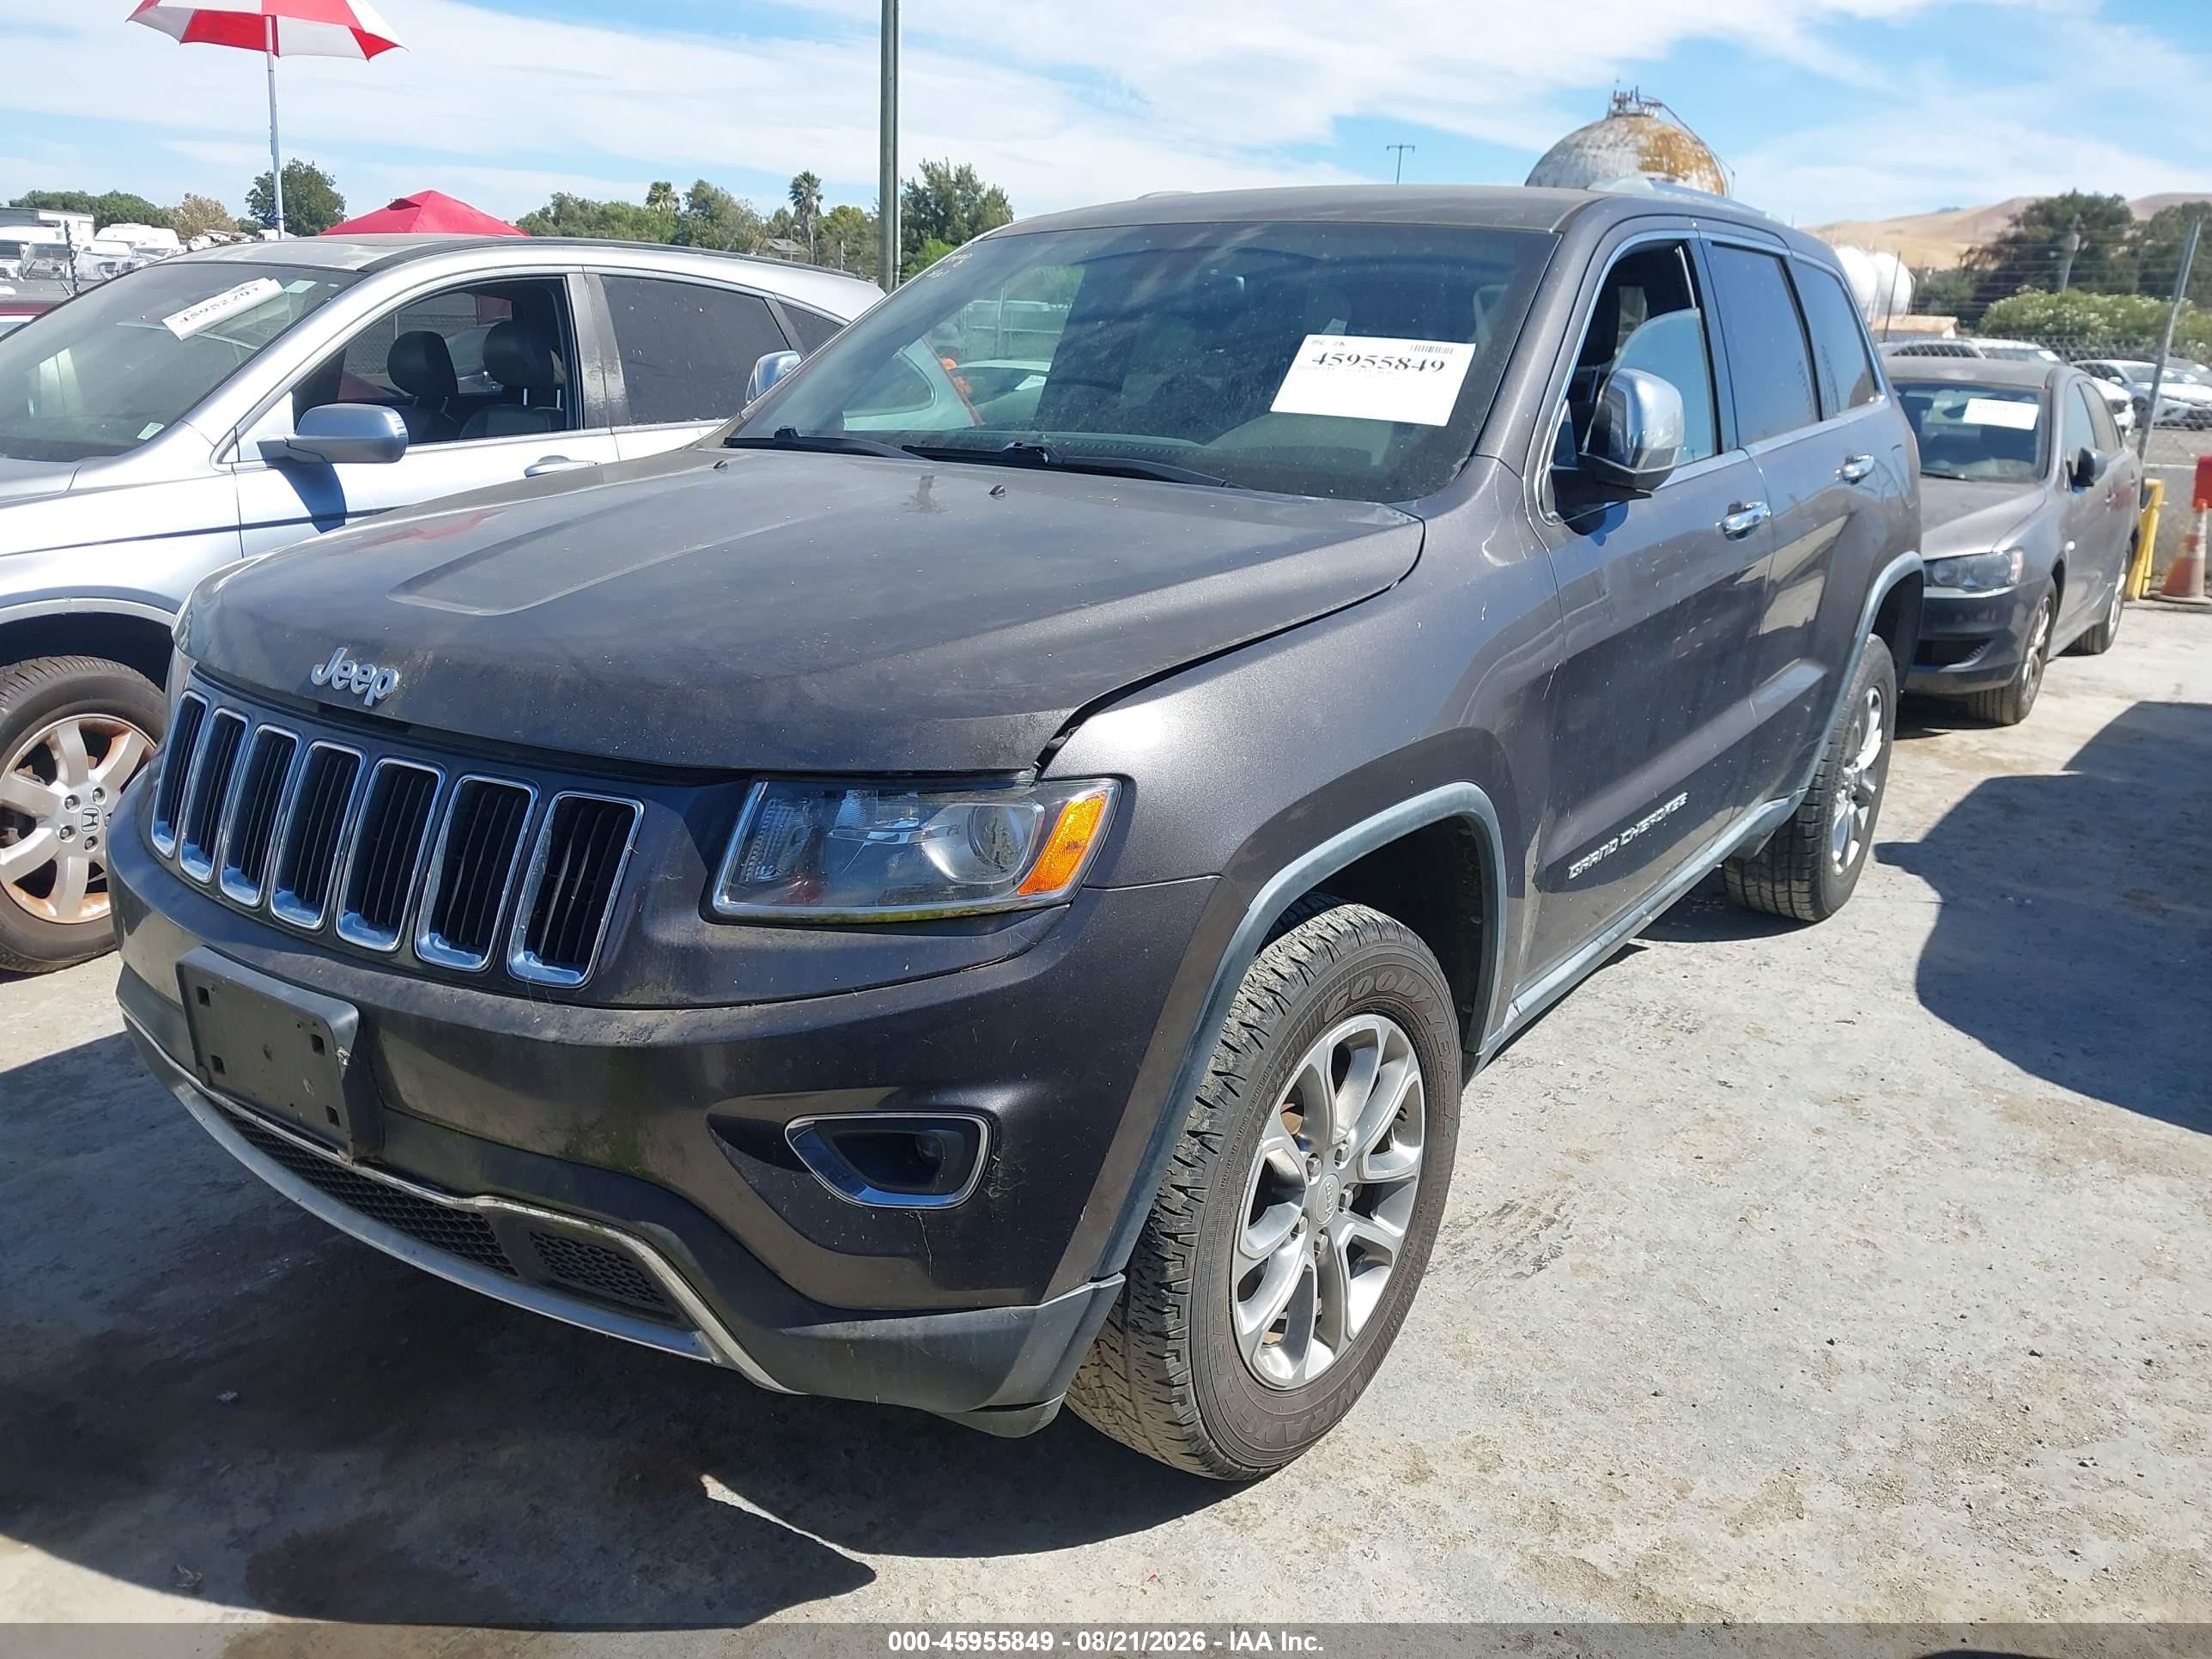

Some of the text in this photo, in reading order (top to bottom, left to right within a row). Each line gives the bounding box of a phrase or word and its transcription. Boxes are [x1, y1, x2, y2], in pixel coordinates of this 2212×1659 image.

[1311, 352, 1445, 373] 45955849
[310, 647, 399, 707] Jeep
[1568, 837, 1619, 880] GRAND
[1324, 970, 1453, 1141] GOODYEAR
